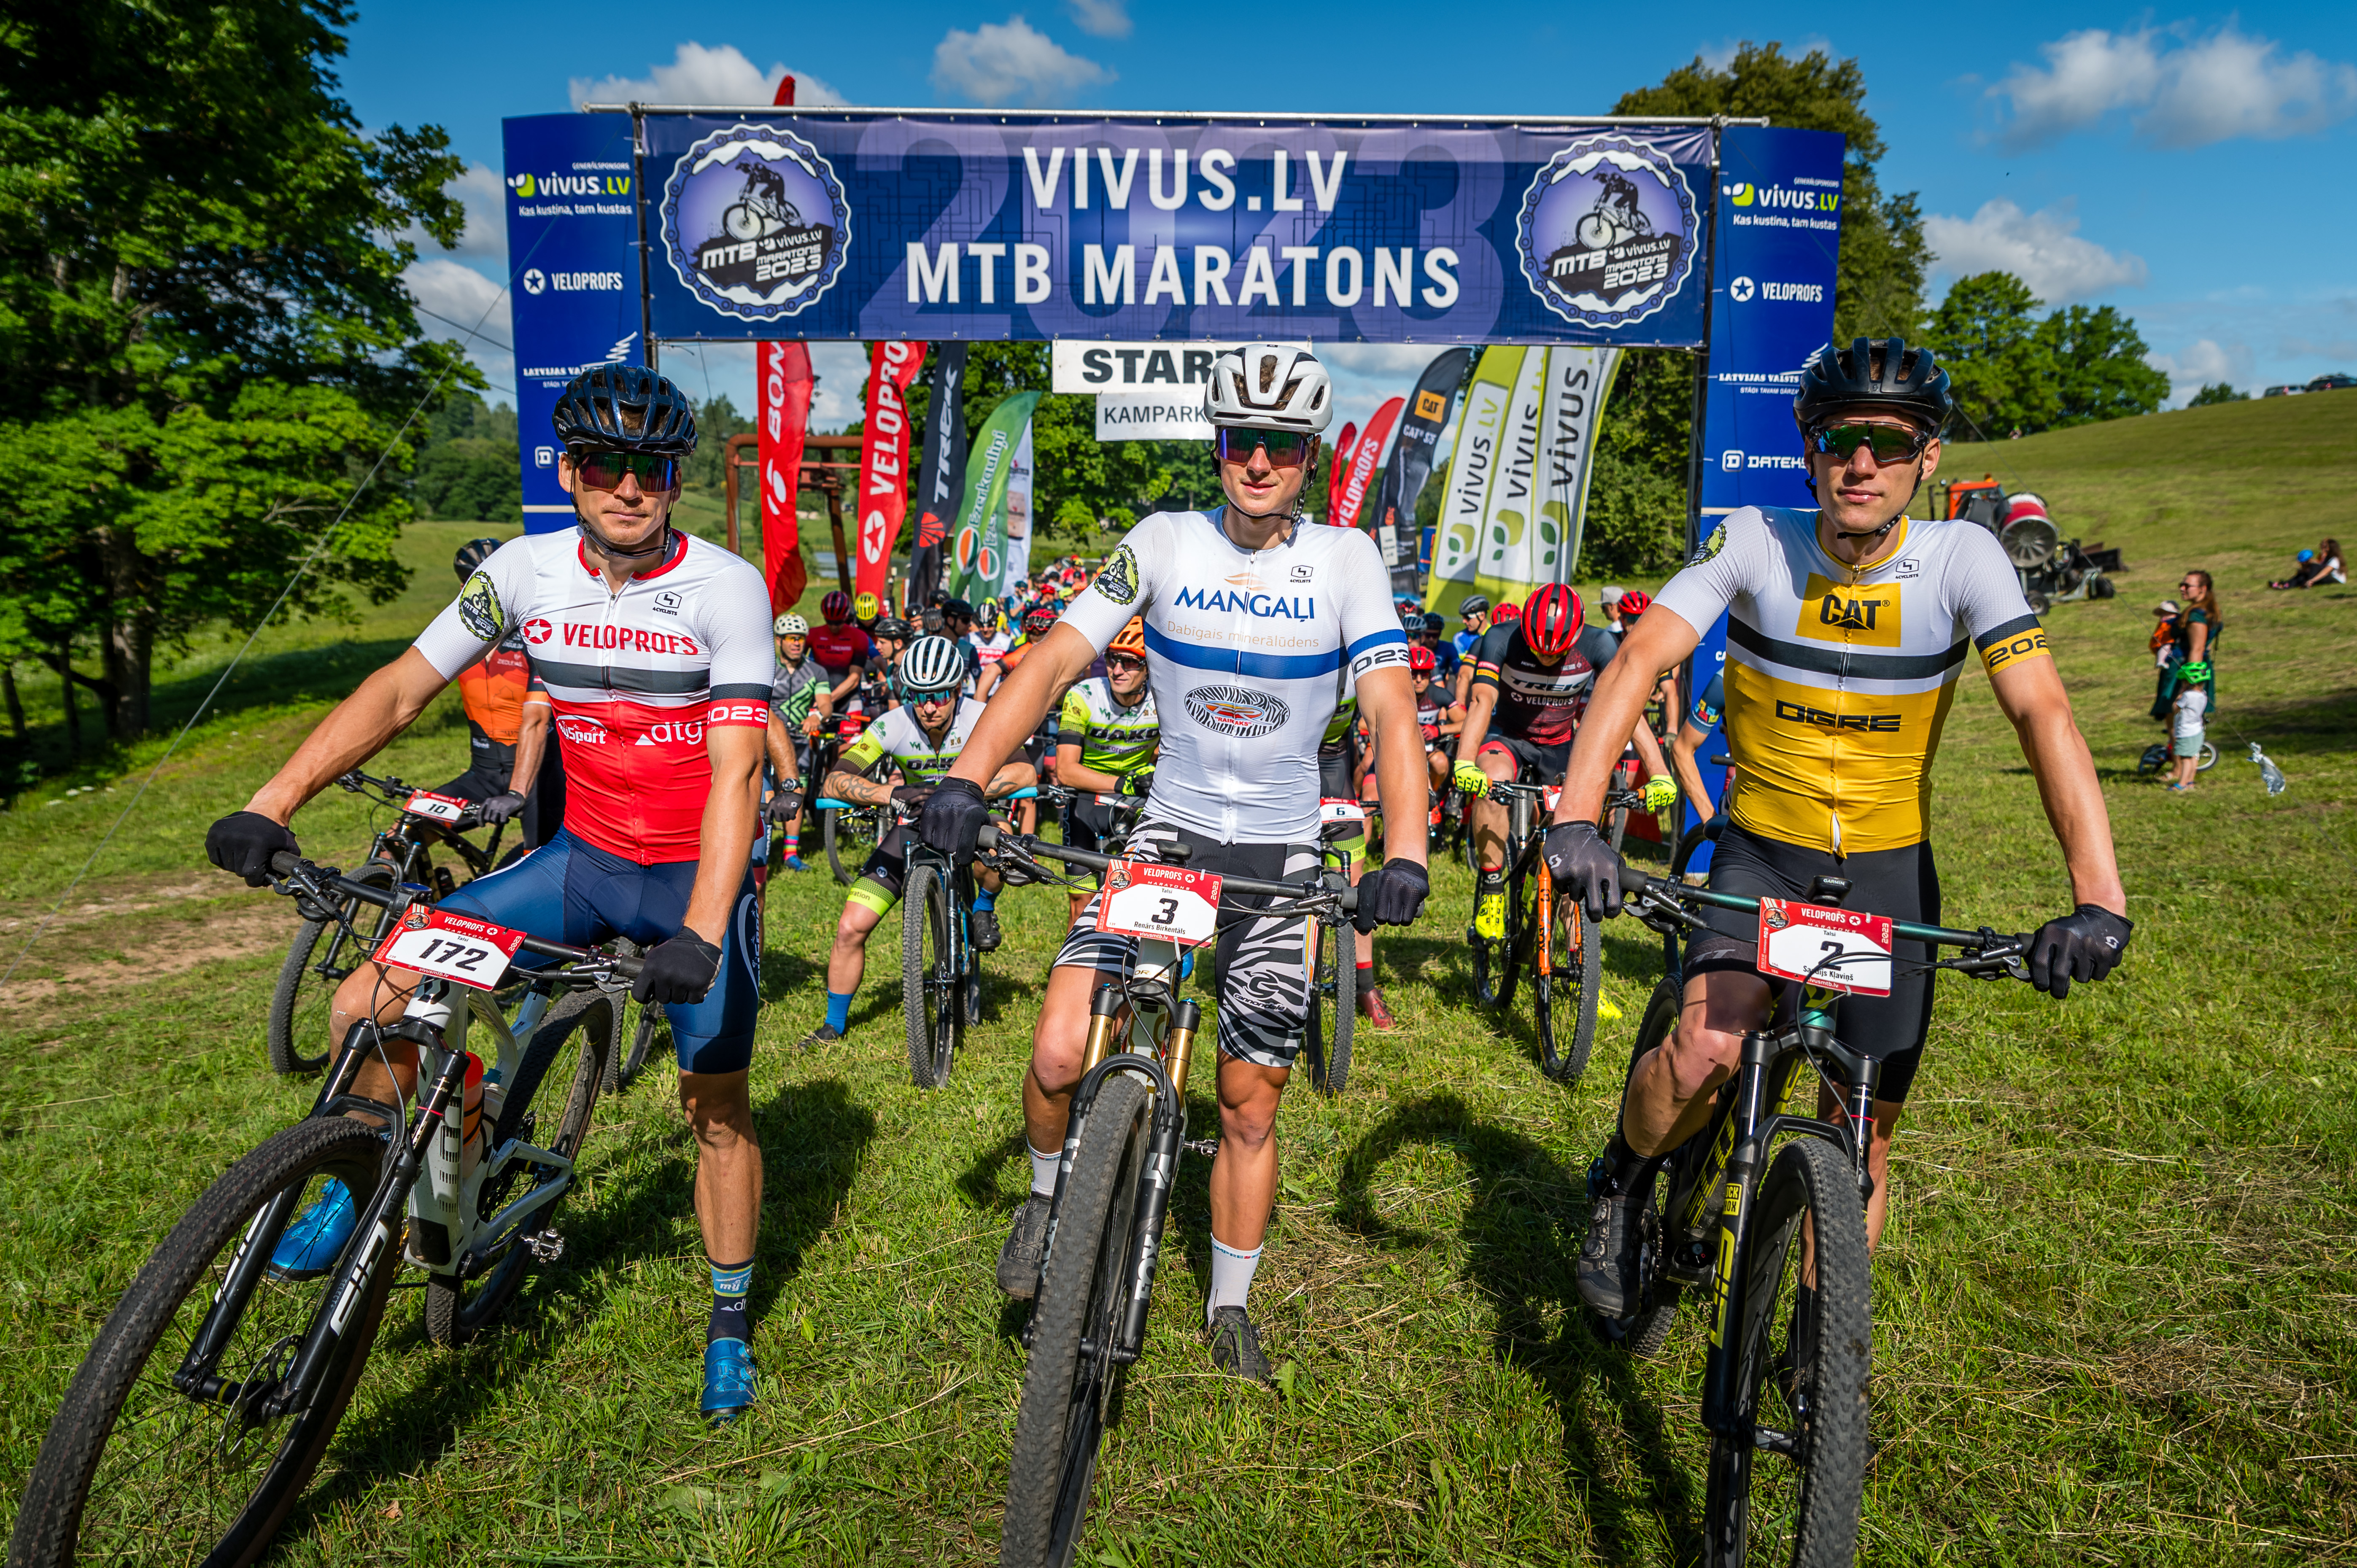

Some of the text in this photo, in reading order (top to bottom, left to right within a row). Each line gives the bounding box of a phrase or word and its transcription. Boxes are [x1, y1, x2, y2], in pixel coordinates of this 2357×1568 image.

[1022, 147, 1348, 212] VIVUS.LV
[519, 205, 535, 216] Kas
[574, 204, 596, 215] tam
[597, 202, 633, 215] kustas
[1733, 214, 1752, 225] Kas
[1791, 217, 1809, 228] tam
[1810, 218, 1837, 230] kustas
[702, 241, 757, 270] MTB
[757, 244, 821, 265] MARATONS
[1553, 249, 1607, 277] MTB
[1605, 253, 1669, 273] MARATONS
[756, 257, 822, 282] 2023
[907, 242, 1460, 309] MTB MARATONS
[1603, 262, 1669, 290] 2023
[551, 272, 623, 291] VELOPROFS
[1762, 282, 1823, 302] VELOPROFS
[523, 368, 566, 376] LATVIJAS
[1719, 373, 1766, 382] LATVIJAS
[767, 341, 785, 444] BON
[1105, 405, 1208, 424] KAMPARK
[1423, 399, 1439, 414] CAT
[870, 340, 909, 495] VELOPRO
[934, 362, 957, 503] TREK
[1339, 437, 1379, 527] VELOPROFS
[1108, 584, 1128, 598] 2023
[463, 600, 479, 615] MTB
[653, 607, 677, 616] 4CYCLISTS
[1174, 586, 1315, 623] MANGAĻI
[475, 618, 496, 635] 2023
[1168, 620, 1223, 642] Dabīgais
[564, 623, 698, 655] VELOPROFS
[1988, 634, 2048, 669] 202
[1354, 649, 1409, 675] 023
[1511, 676, 1582, 692] TREK
[1526, 697, 1574, 706] VELOPROFS
[707, 706, 768, 725] 023
[1776, 699, 1901, 733] OGRE
[651, 721, 702, 745] dtg
[1089, 727, 1160, 741] DAKO
[906, 757, 957, 771] DAK
[428, 803, 448, 814] 10
[1337, 807, 1345, 815] 6
[1143, 868, 1182, 881] VELOPROFS
[1147, 881, 1190, 891] MARATONS
[1211, 881, 1219, 900] 2023
[1152, 898, 1178, 924] 3
[1801, 908, 1845, 923] VELOPROFS
[444, 916, 485, 932] VELOPROFS
[1134, 921, 1186, 935] Renārs Birkentāls
[445, 928, 489, 941] MARATONS
[508, 935, 523, 952] 2023
[1139, 932, 1168, 940] vivusmtb.lv
[418, 939, 489, 972] 172
[1818, 940, 1844, 971] 2
[418, 967, 449, 978] vivusmtb.lv
[1803, 965, 1853, 981] Sadijs Kļaviņš
[1235, 994, 1285, 1011] cannondale
[1723, 1199, 1737, 1213] HOX
[1134, 1234, 1161, 1300] FOX
[734, 1299, 746, 1311] dt
